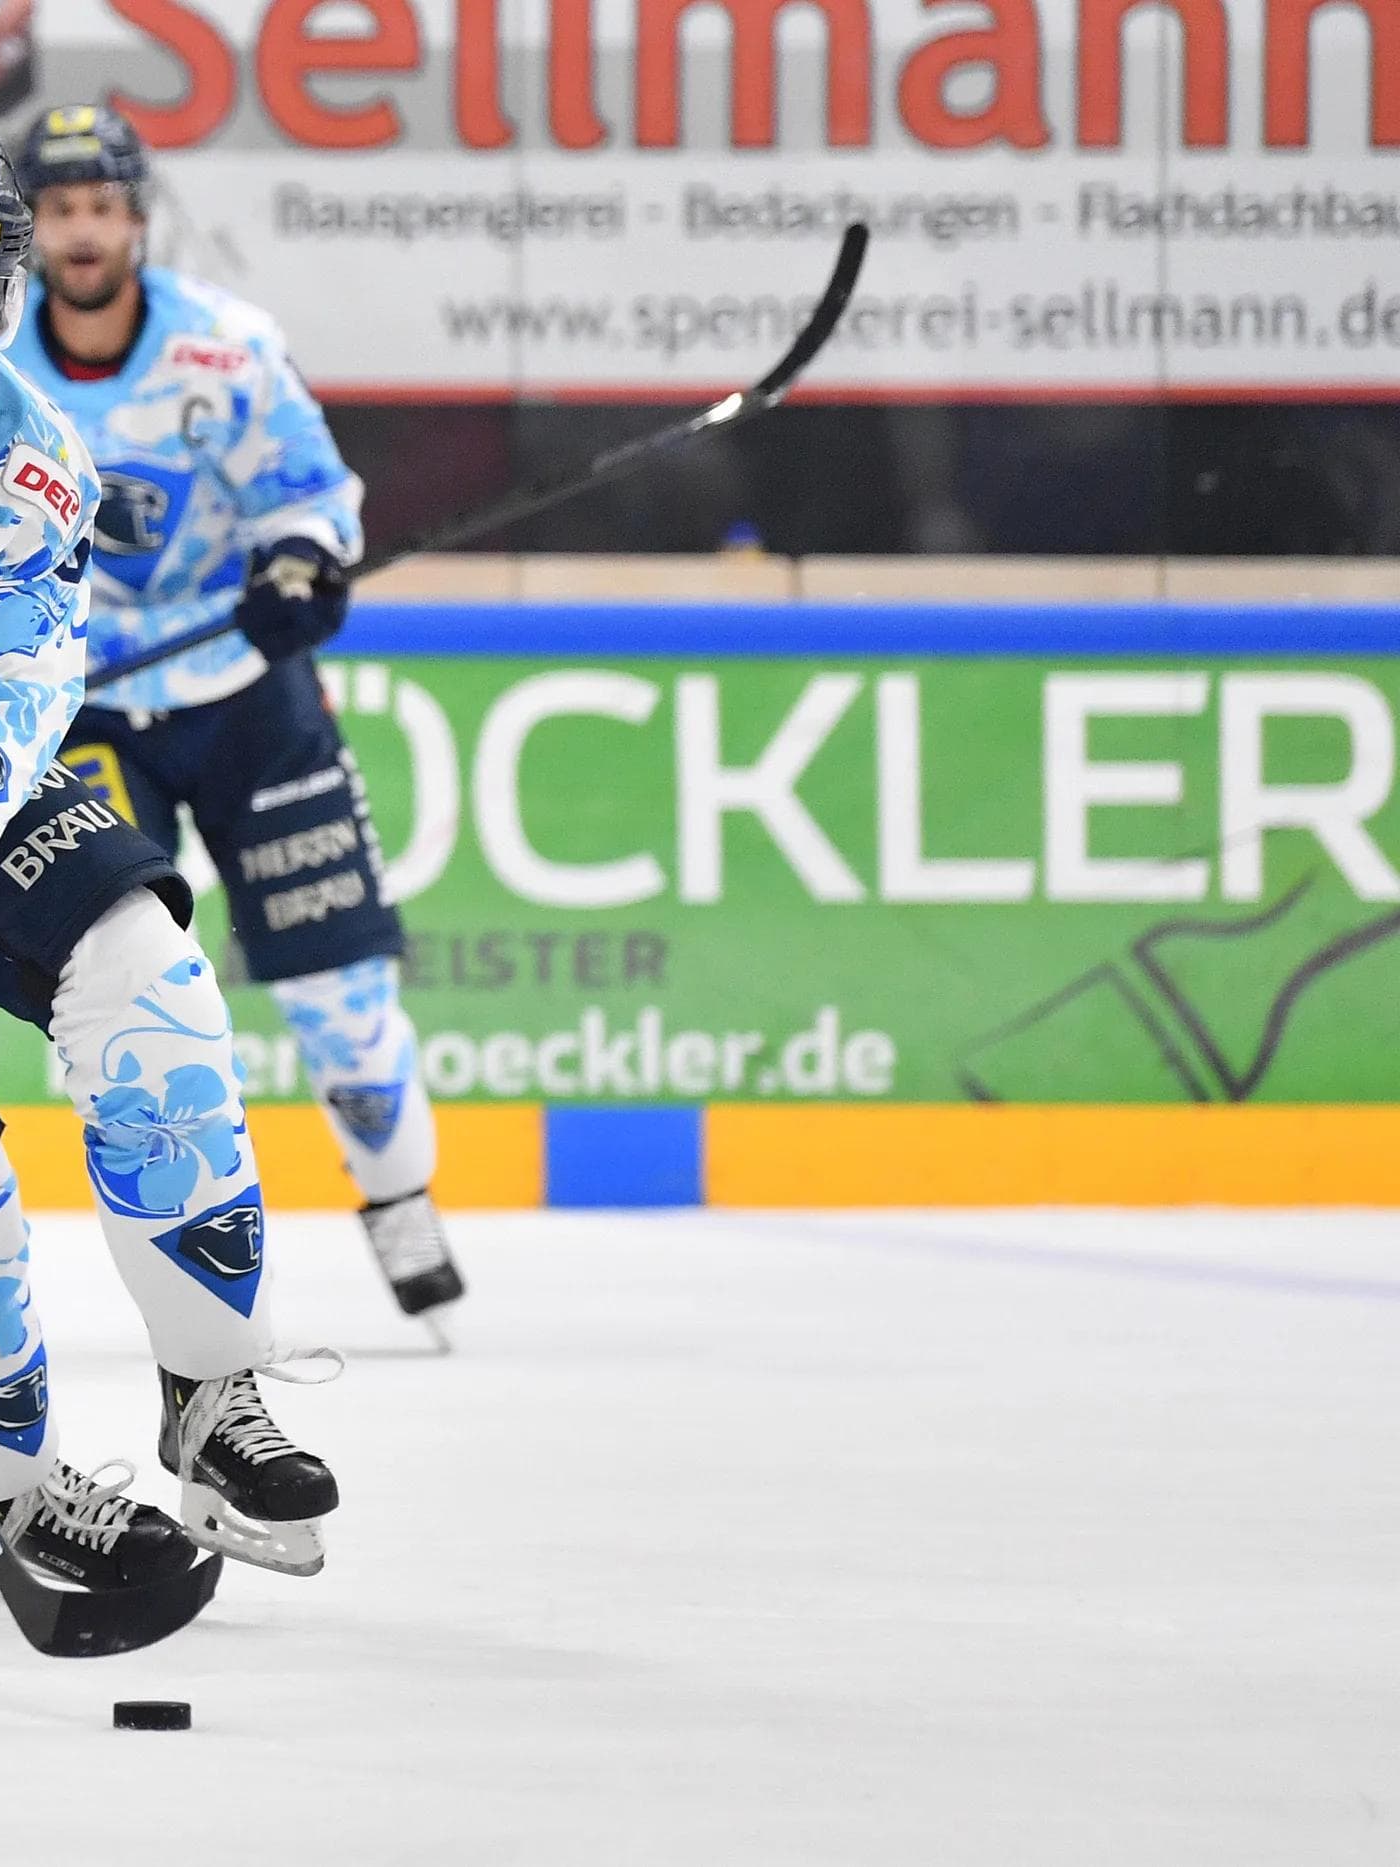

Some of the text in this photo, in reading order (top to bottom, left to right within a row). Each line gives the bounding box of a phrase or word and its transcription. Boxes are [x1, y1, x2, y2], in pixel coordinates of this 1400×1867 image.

[100, 0, 1400, 151] Sellmann
[1078, 180, 1400, 240] Flachdachba
[440, 277, 1400, 364] www.spenerei-sellmann.d
[0, 800, 119, 891] BRÄU
[403, 930, 670, 990] EISTER
